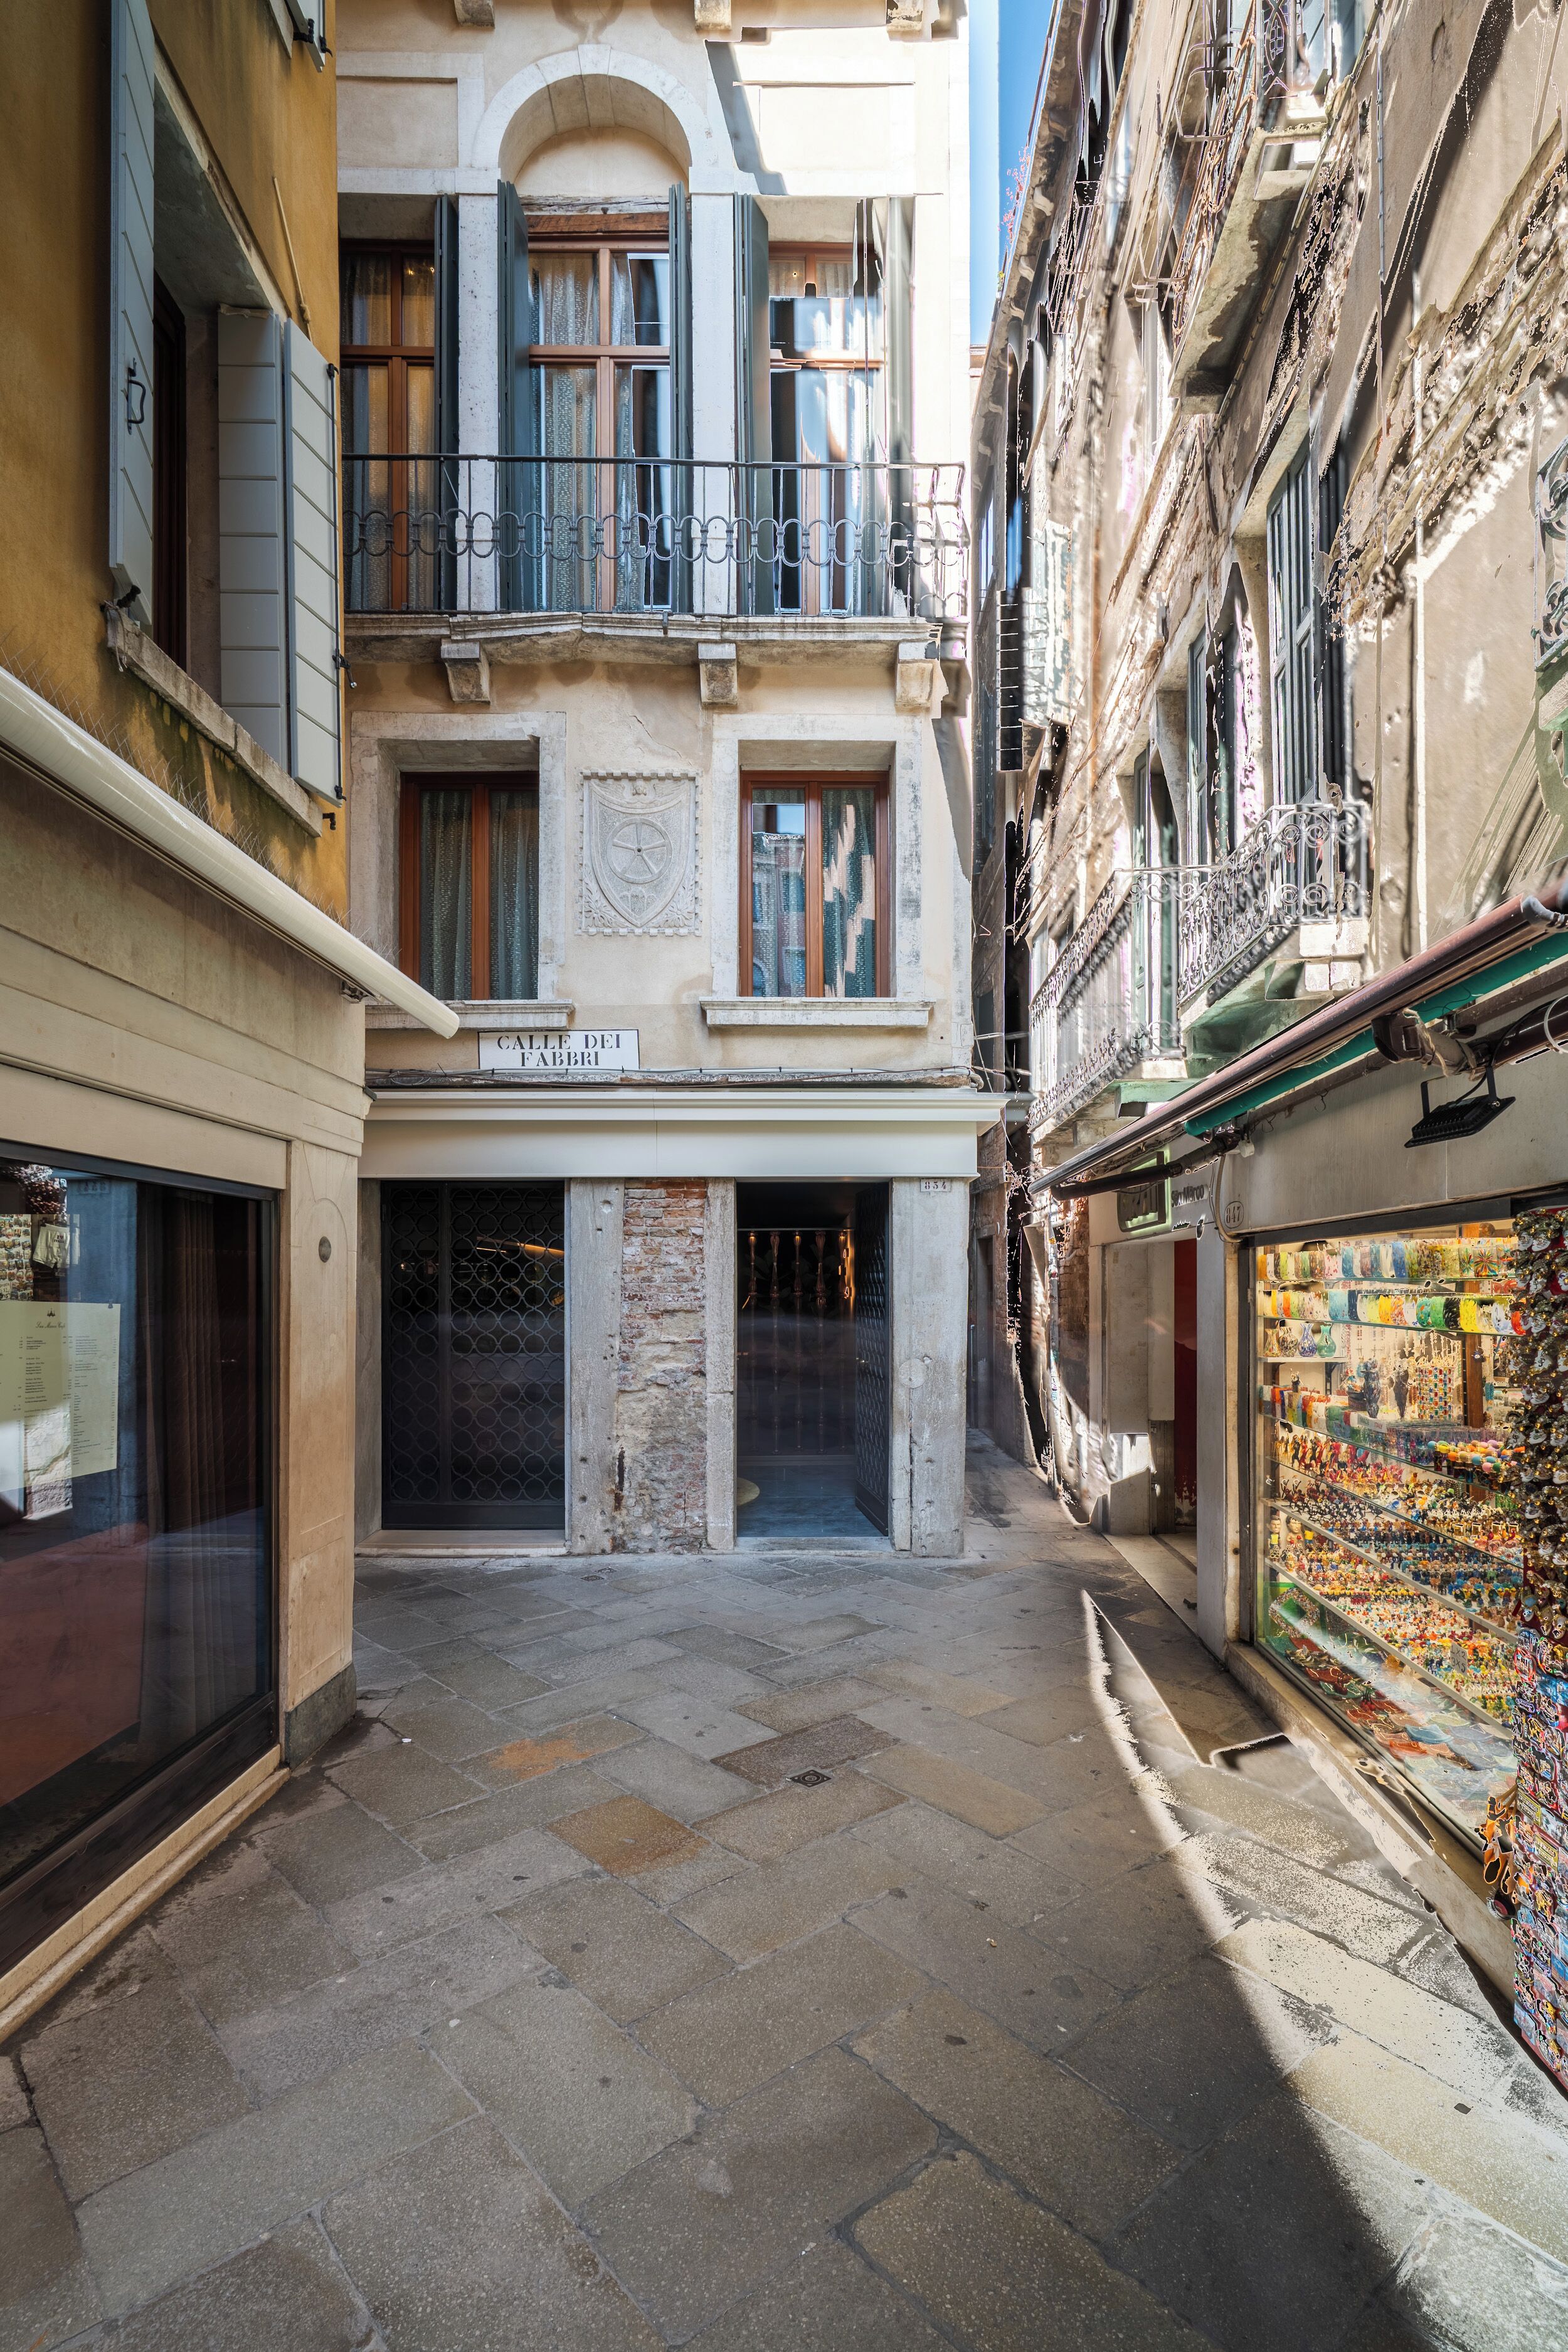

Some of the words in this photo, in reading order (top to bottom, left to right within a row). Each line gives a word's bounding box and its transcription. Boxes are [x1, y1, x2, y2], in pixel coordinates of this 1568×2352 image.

[497, 1034, 571, 1050] CALLE
[585, 1034, 621, 1049] DEI
[521, 1051, 599, 1067] FABBRI
[1226, 1205, 1241, 1224] 847
